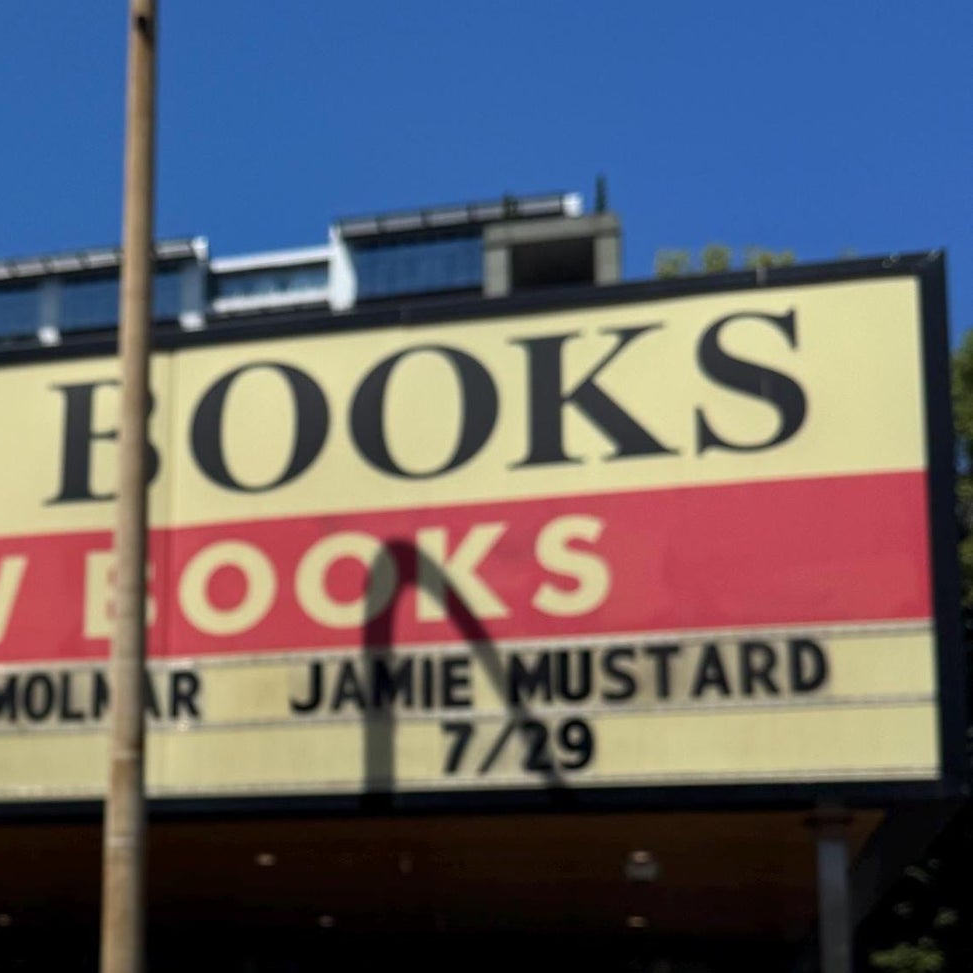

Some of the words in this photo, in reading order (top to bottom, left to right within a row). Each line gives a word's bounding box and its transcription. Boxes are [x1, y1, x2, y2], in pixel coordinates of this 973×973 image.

[42, 308, 807, 506] BOOKS
[82, 515, 613, 640] BOOKS
[290, 655, 472, 715] JAMIE
[510, 638, 828, 702] MUSTARD
[441, 718, 595, 775] 7/29
